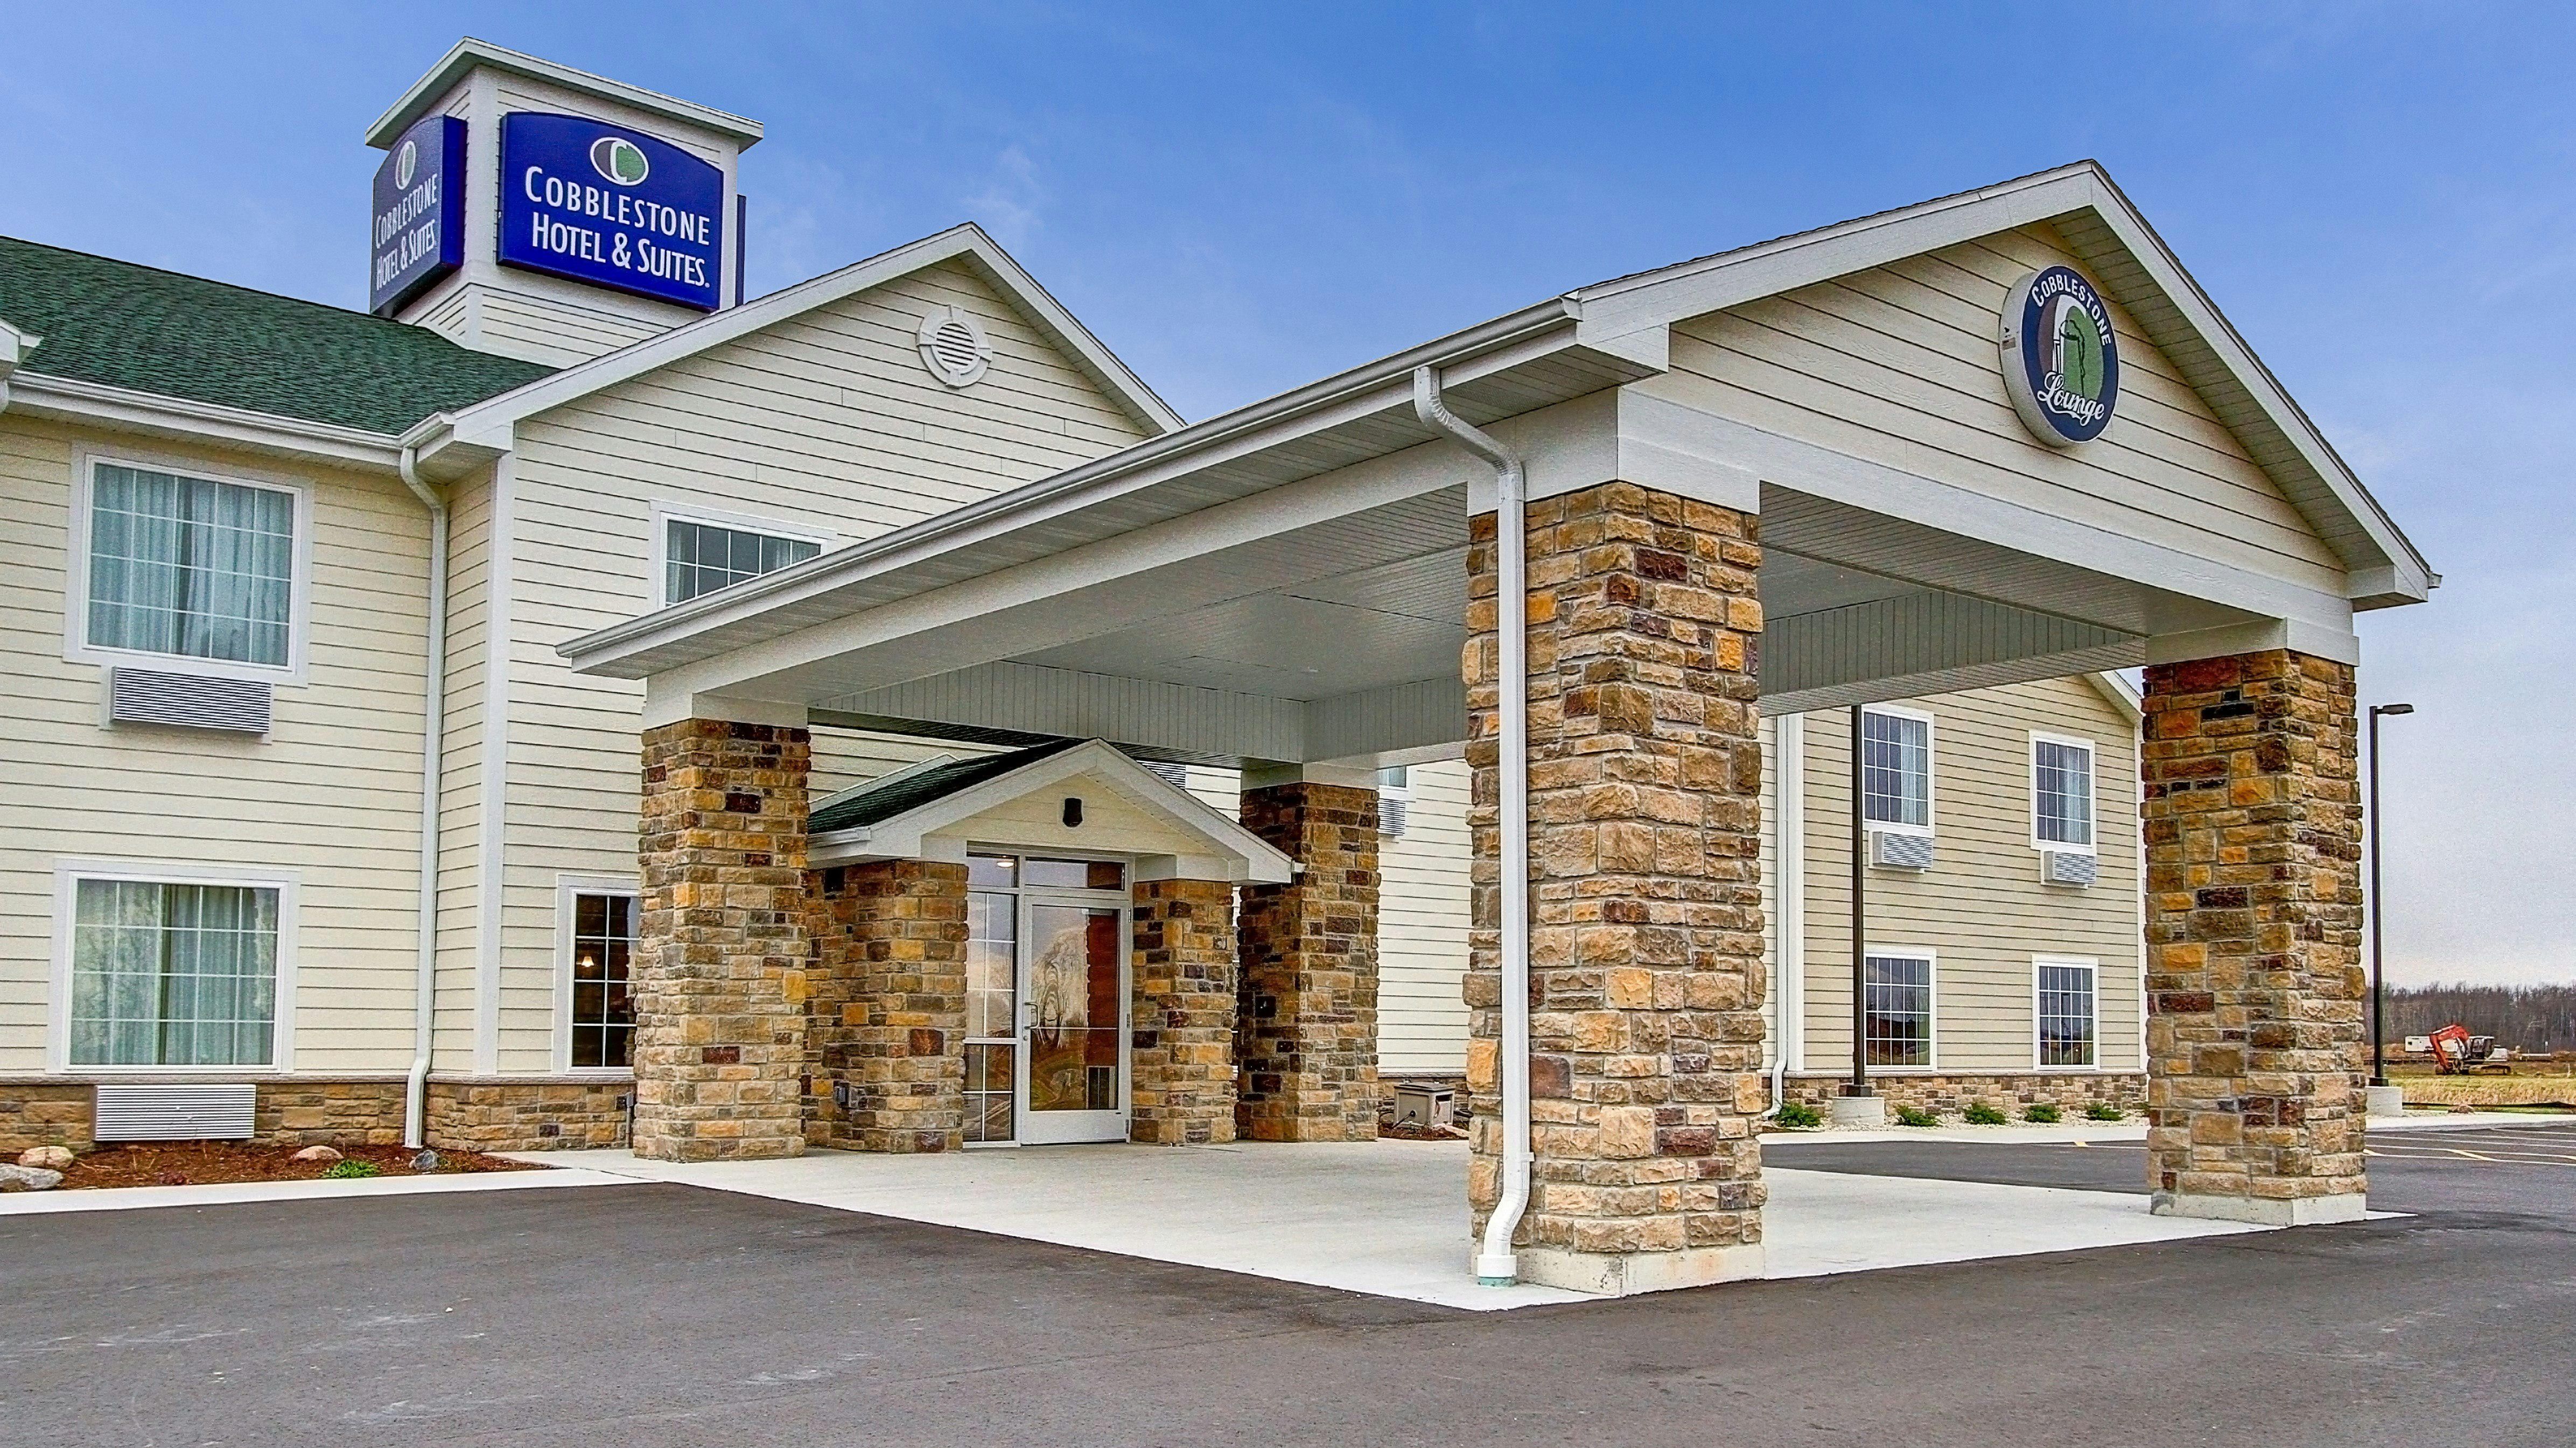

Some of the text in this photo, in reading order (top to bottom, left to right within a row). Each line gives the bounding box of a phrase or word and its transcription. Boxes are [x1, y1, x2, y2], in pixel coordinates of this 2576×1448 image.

[376, 173, 437, 249] COBBLESTONE
[526, 166, 710, 245] COBBLESTONE
[376, 248, 400, 291] HOTEL
[400, 236, 408, 271] &
[532, 212, 606, 263] HOTEL
[612, 233, 631, 269] &
[2032, 274, 2111, 346] COBBLESTONE
[2037, 371, 2104, 426] Lounge
